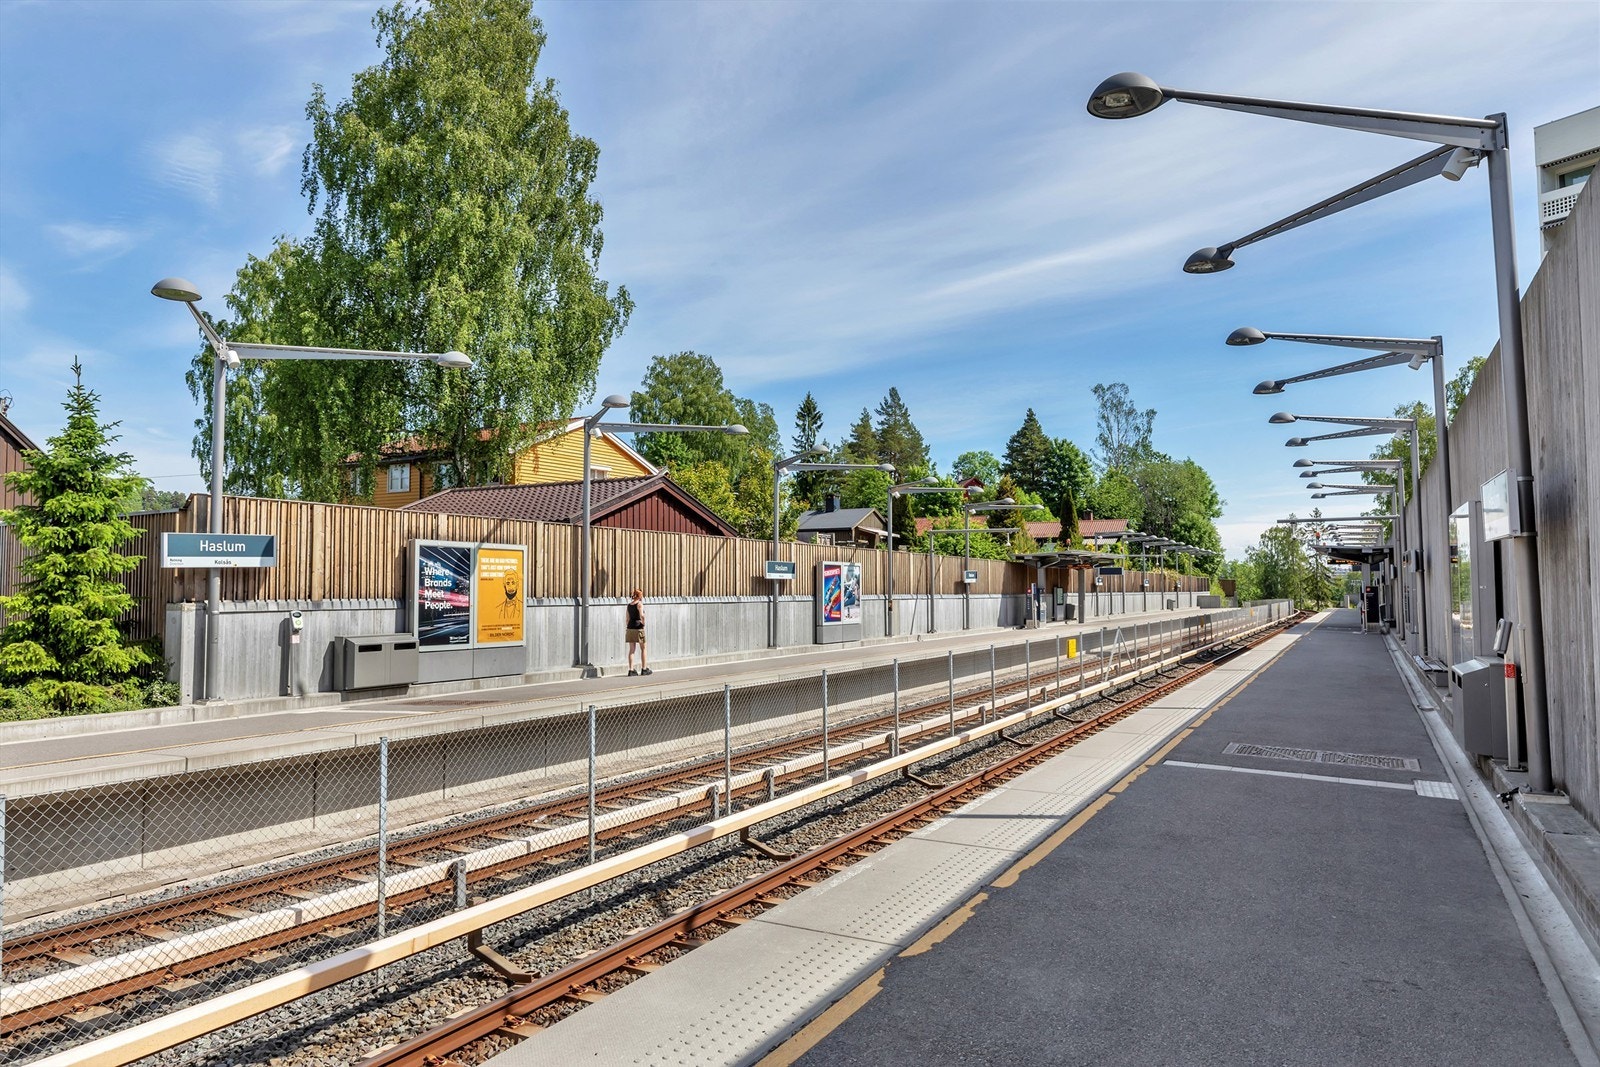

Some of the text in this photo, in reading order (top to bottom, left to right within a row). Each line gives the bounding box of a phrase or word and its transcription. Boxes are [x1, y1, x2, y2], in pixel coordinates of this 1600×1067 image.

[200, 540, 246, 552] Haslum
[424, 567, 450, 576] Where
[424, 578, 452, 587] Brands
[424, 589, 445, 598] Meet
[424, 600, 453, 611] People.
